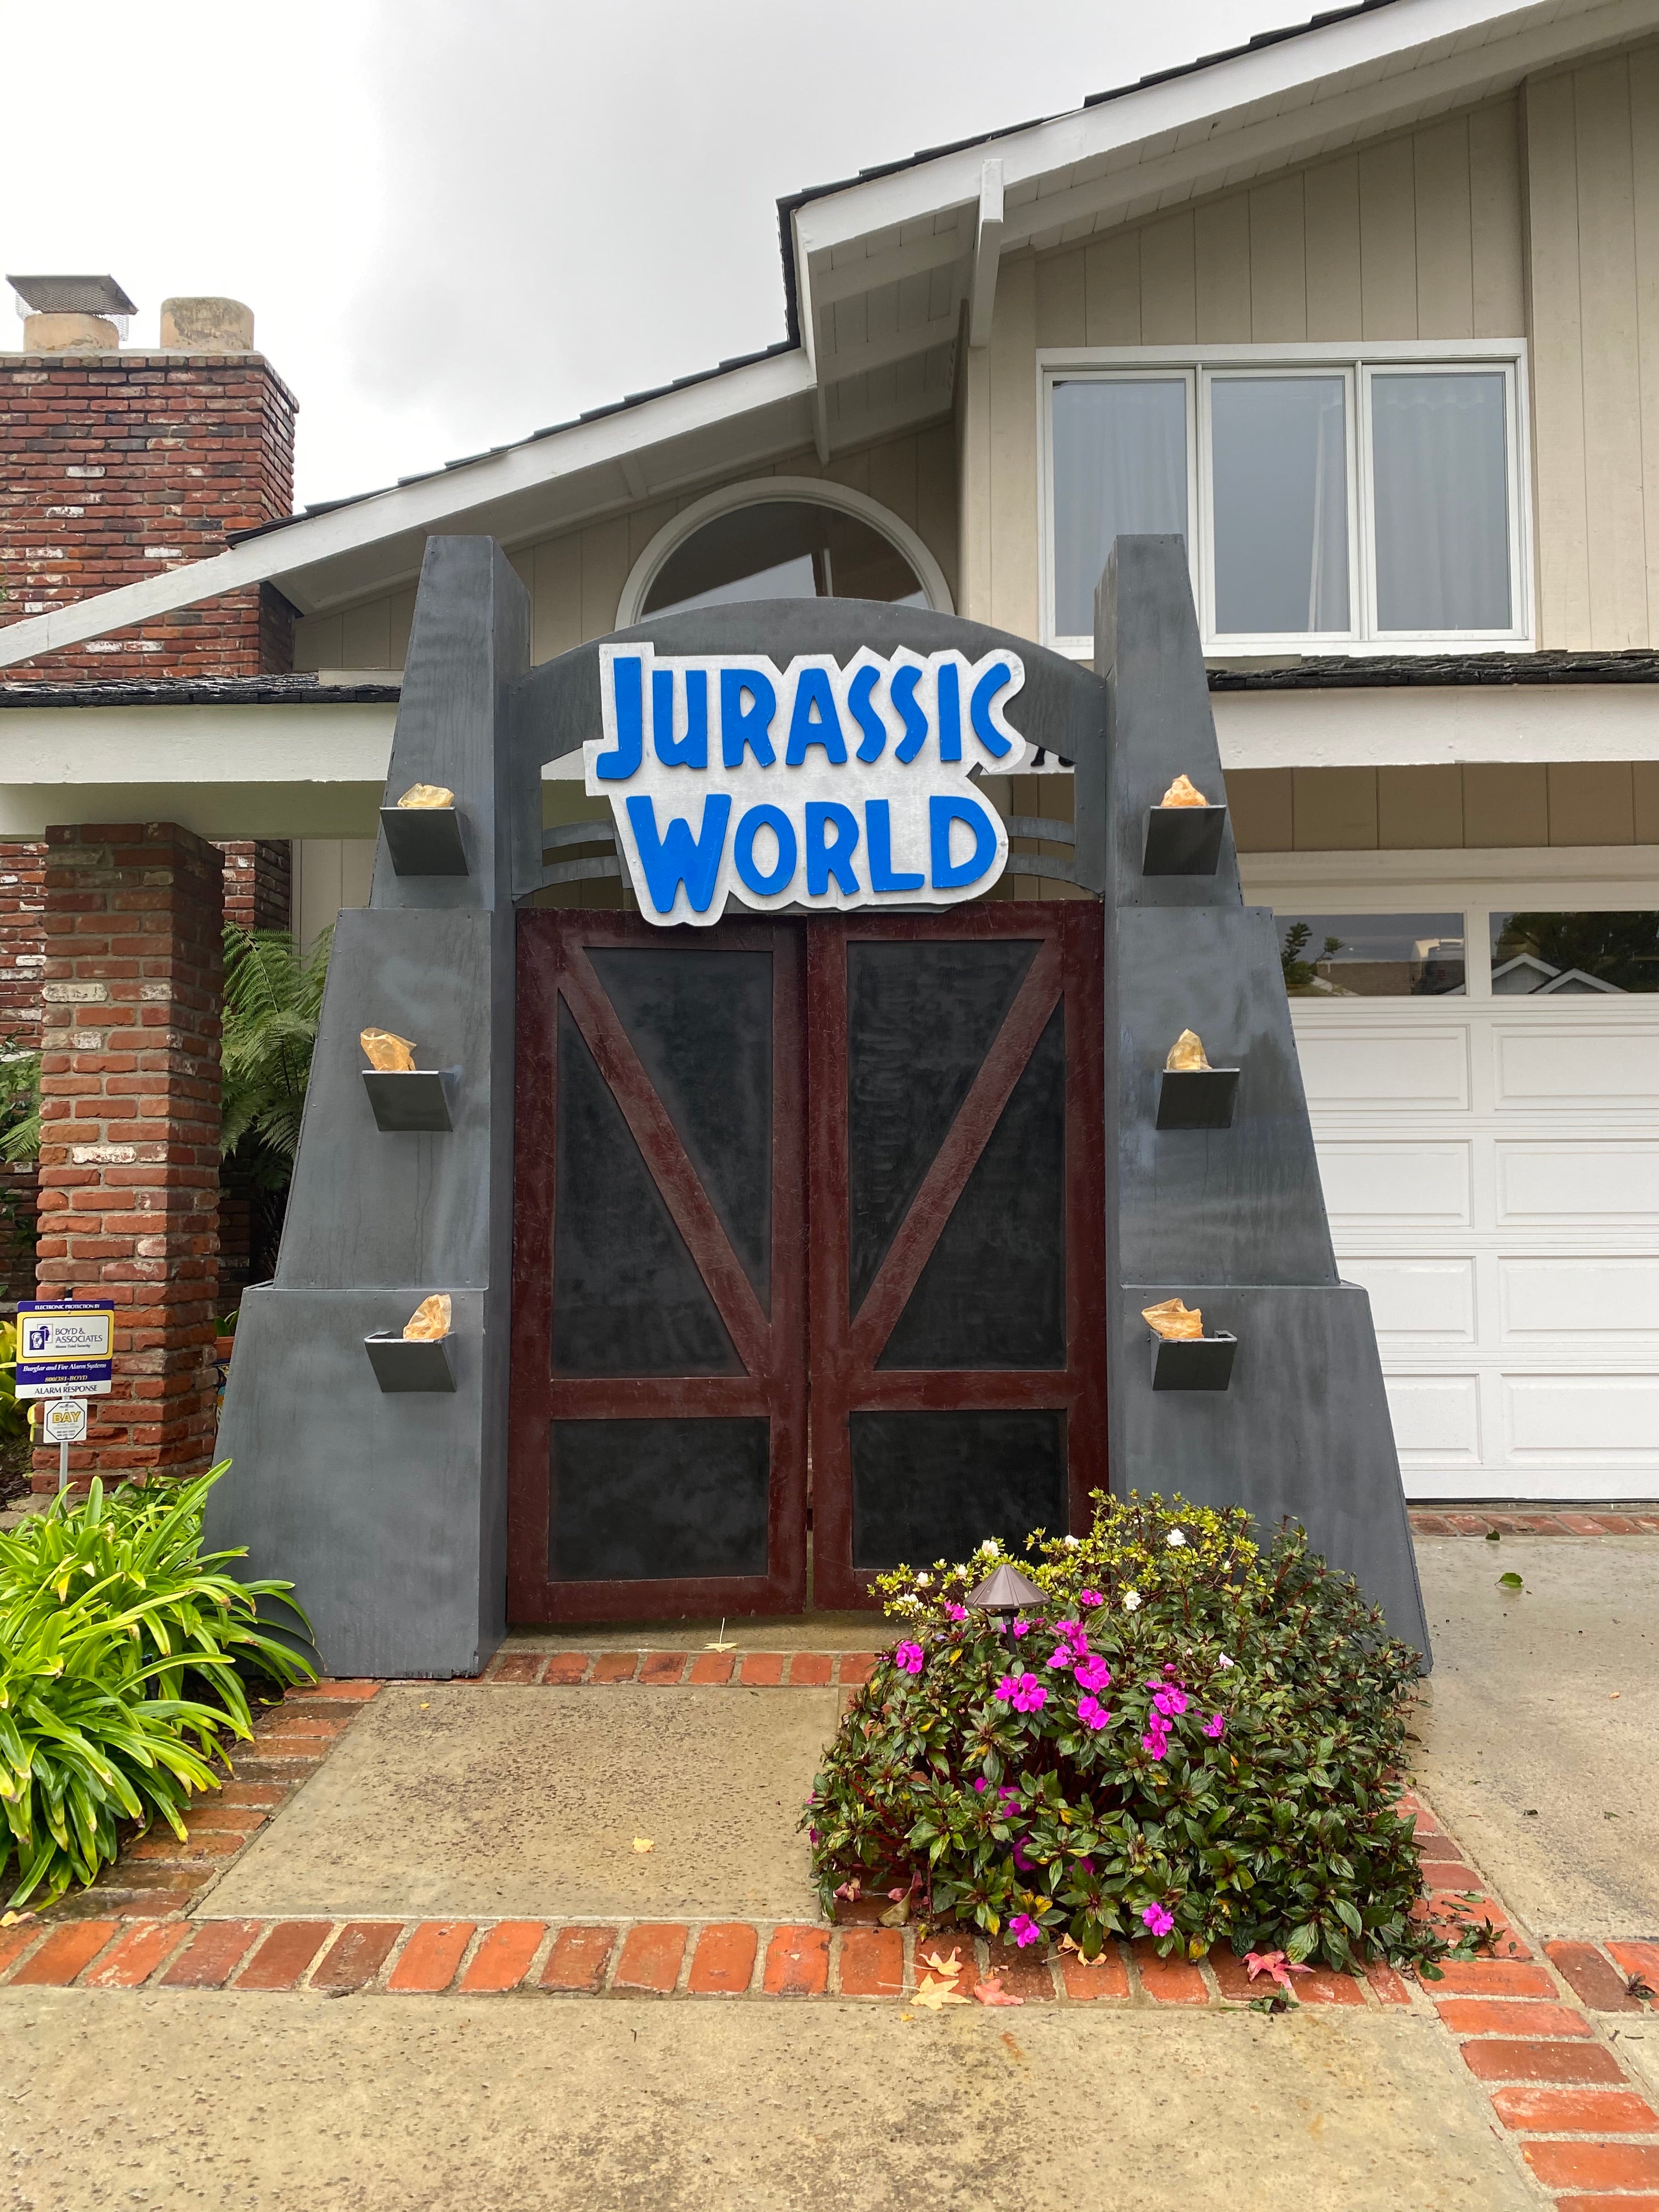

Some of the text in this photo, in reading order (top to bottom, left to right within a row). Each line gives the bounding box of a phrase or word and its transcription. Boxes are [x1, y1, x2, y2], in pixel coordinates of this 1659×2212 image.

[596, 657, 1012, 779] JURASSIC
[625, 794, 997, 912] WORLD
[55, 1335, 103, 1343] ASSOCIATES
[63, 1385, 98, 1393] RESPONSE
[53, 1412, 81, 1423] BAY
